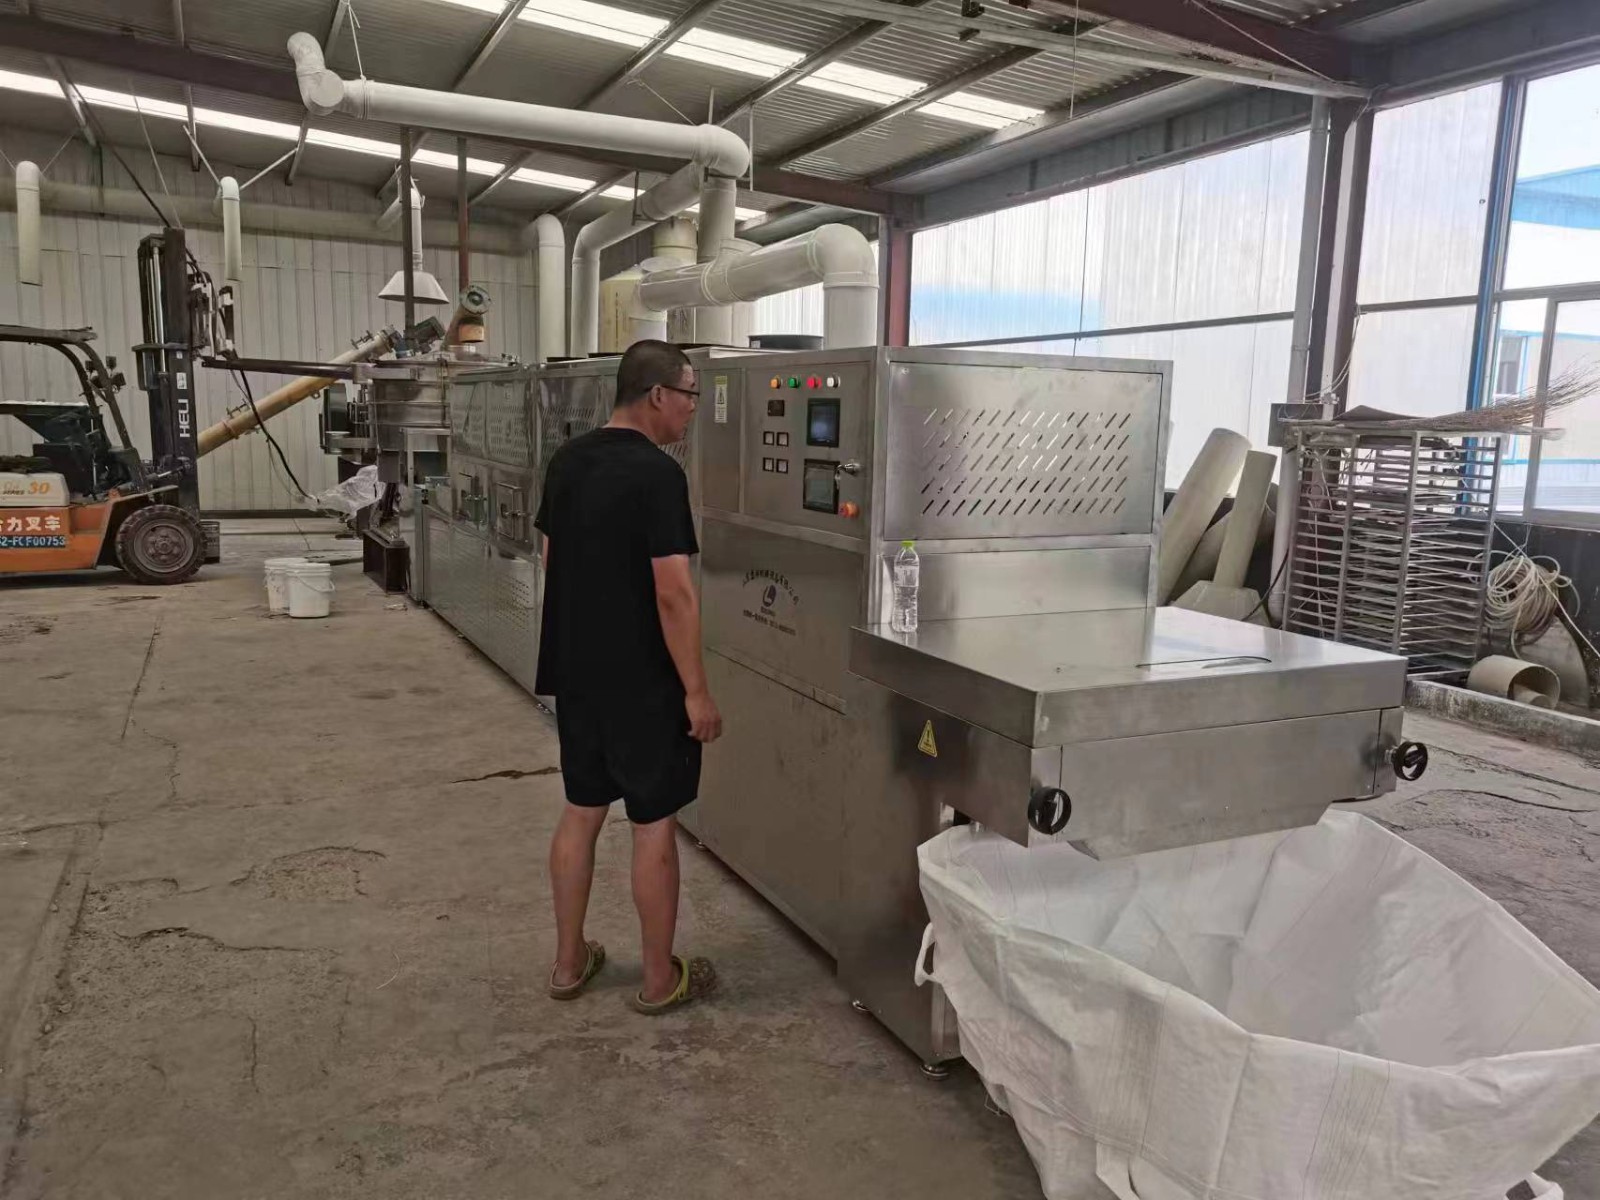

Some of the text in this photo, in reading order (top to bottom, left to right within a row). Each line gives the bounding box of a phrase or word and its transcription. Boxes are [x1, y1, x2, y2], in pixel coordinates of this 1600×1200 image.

[178, 399, 190, 437] HELI
[30, 481, 50, 494] 30
[0, 536, 65, 546] 2-FCF00753
